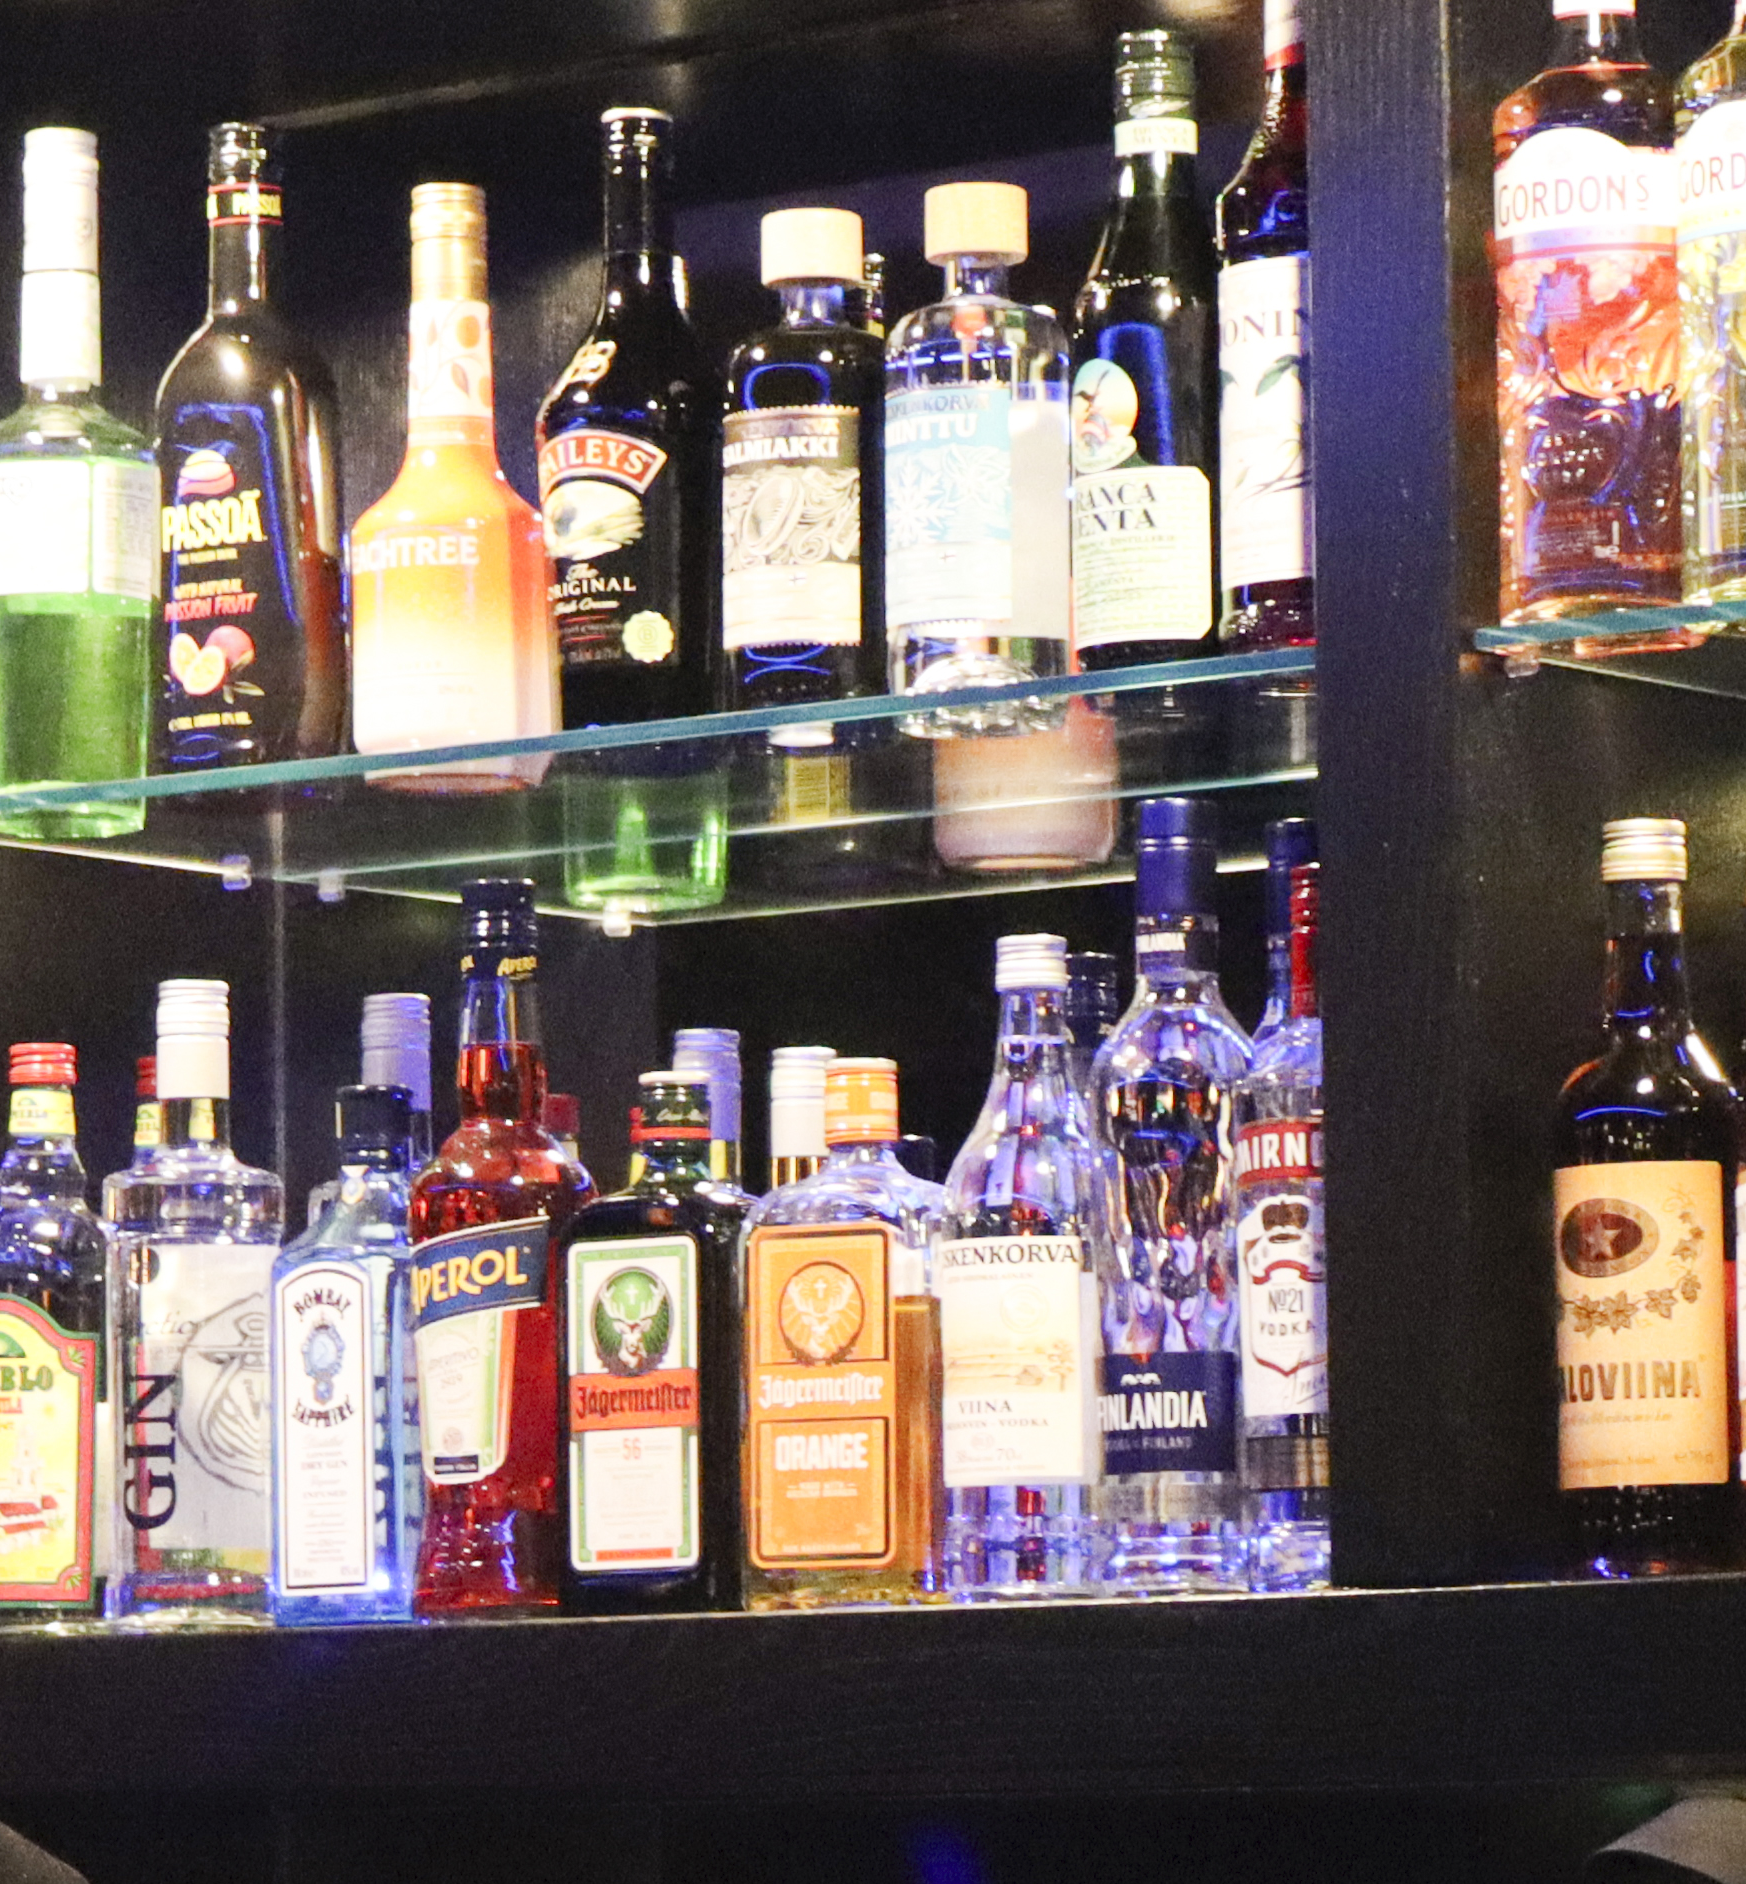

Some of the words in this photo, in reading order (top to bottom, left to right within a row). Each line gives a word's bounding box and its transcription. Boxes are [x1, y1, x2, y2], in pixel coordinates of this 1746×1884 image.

[213, 592, 259, 617] FRUIT
[294, 1287, 352, 1314] BOMBAY
[576, 1383, 692, 1421] Jägermeister
[758, 1371, 885, 1410] Jägermeister
[291, 1400, 356, 1429] SAPPHIRE
[958, 1399, 1013, 1415] VIINA
[122, 1373, 177, 1532] GIN
[621, 1437, 642, 1461] 56
[775, 1432, 869, 1472] ORANGE
